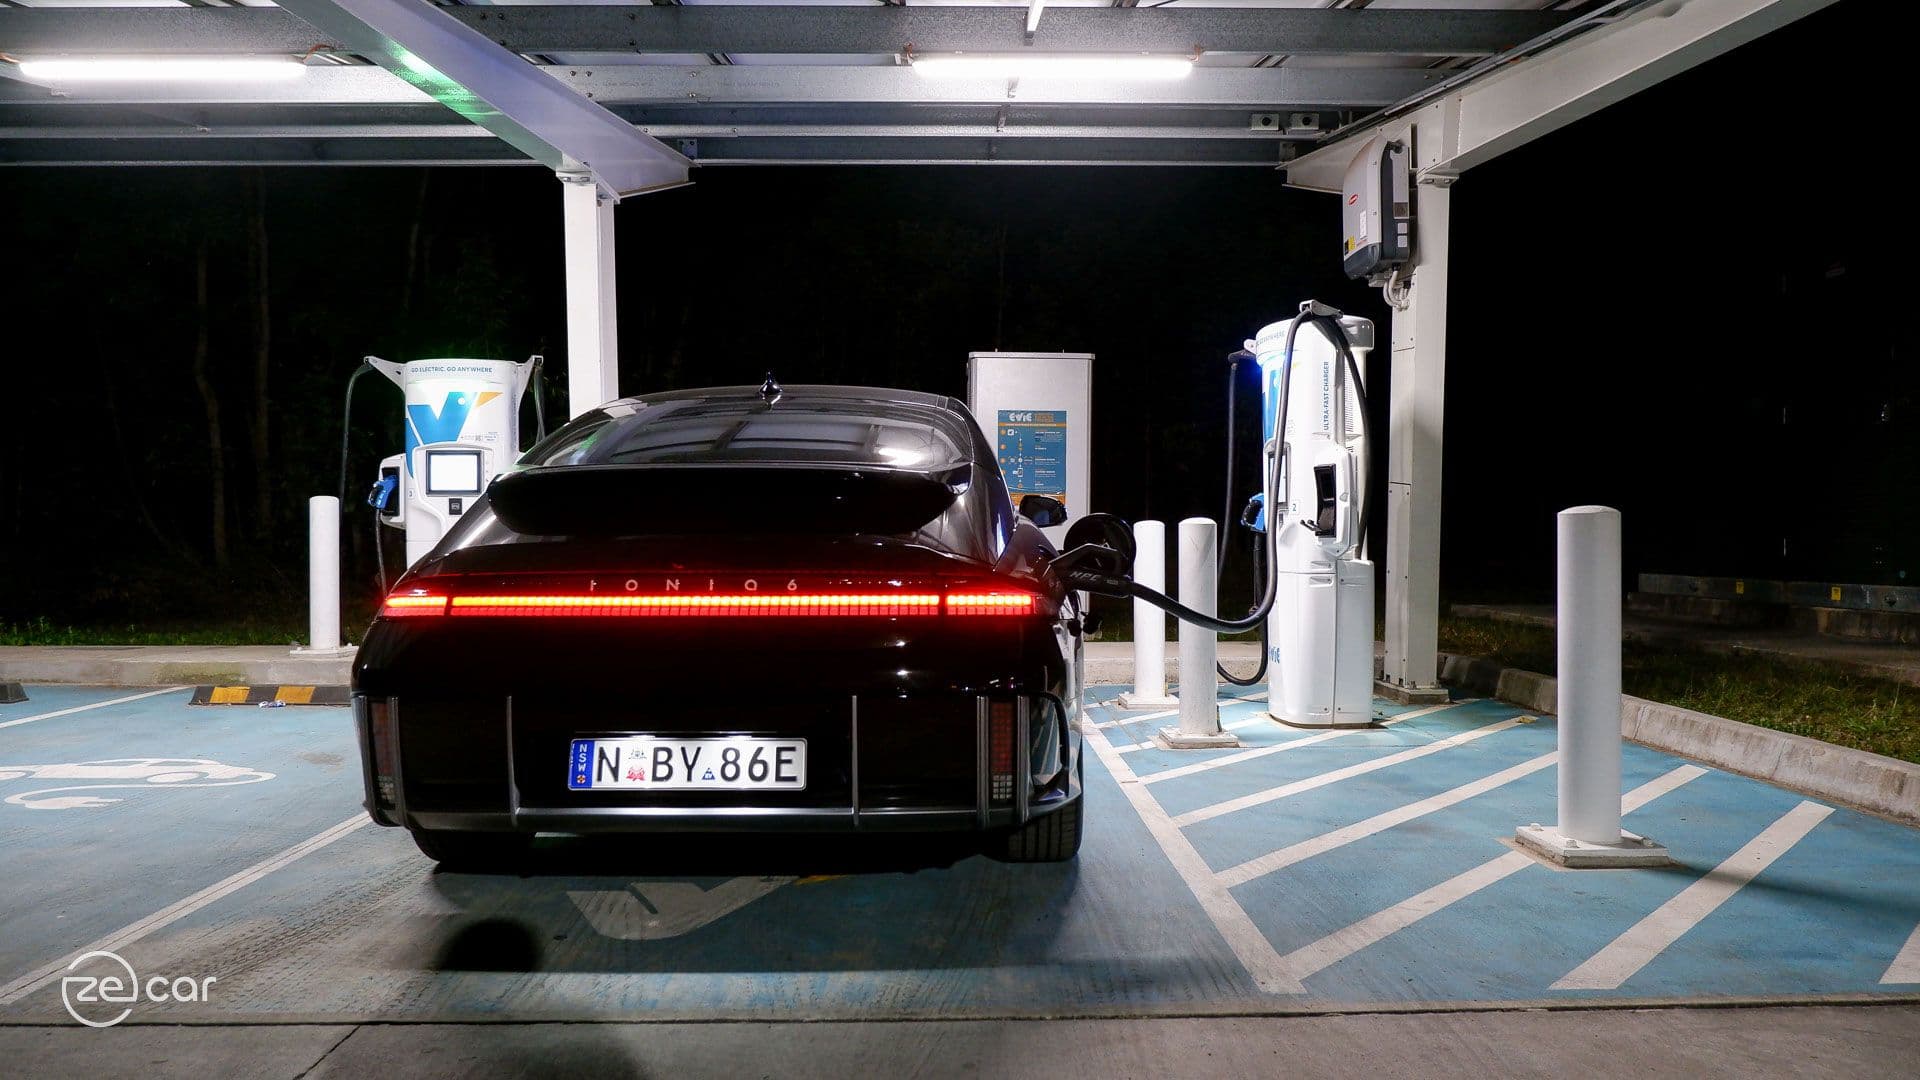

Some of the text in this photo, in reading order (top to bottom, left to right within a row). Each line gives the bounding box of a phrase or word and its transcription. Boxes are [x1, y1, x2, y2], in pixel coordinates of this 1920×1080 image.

[578, 743, 588, 772] NSW
[596, 746, 621, 783] N
[651, 746, 702, 783] BY
[720, 746, 798, 783] 86E
